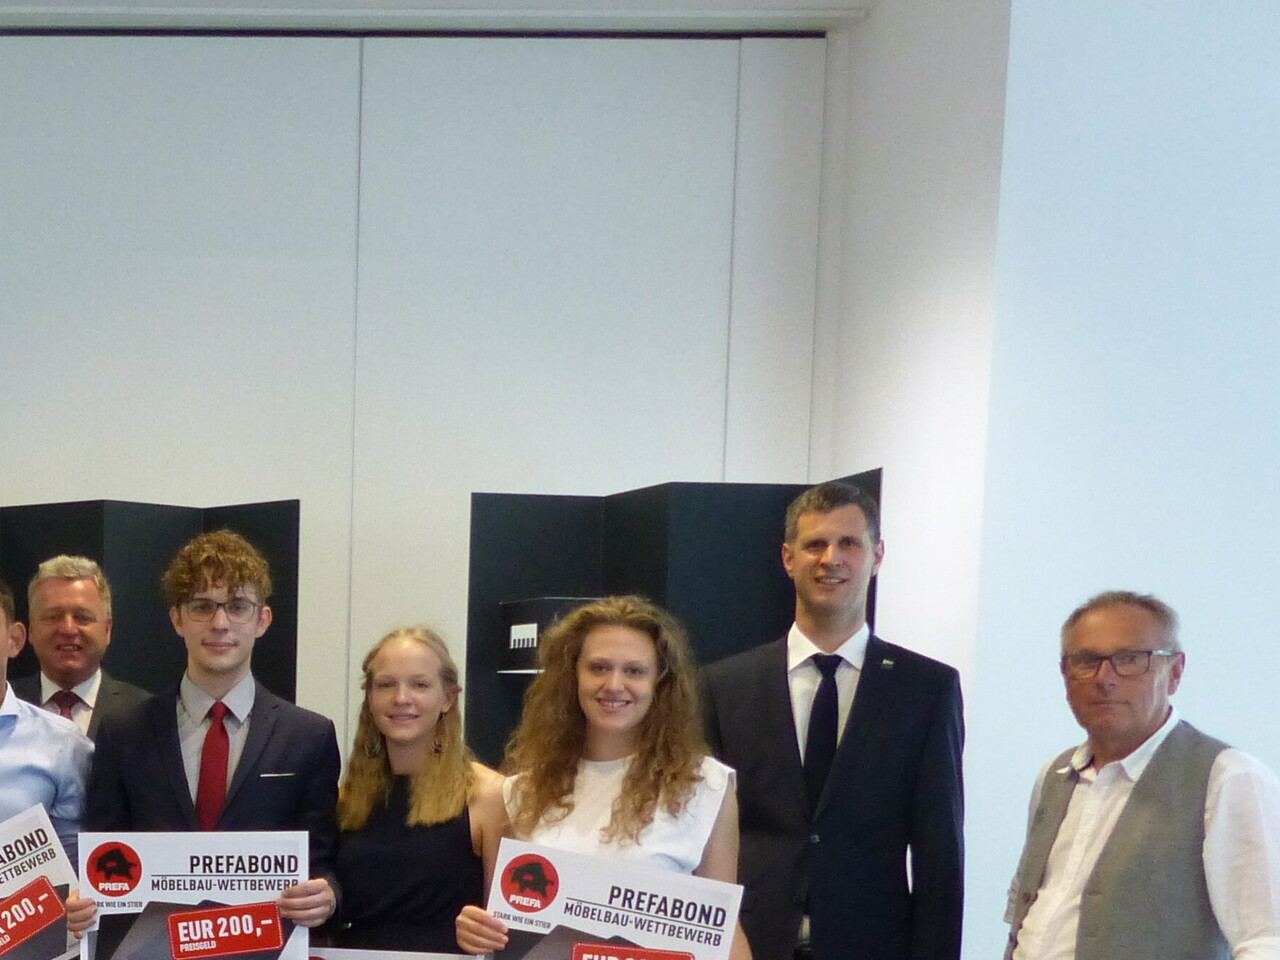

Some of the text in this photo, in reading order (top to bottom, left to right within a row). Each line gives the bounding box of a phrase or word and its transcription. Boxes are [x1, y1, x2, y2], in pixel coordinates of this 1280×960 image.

[189, 855, 298, 873] PREFABOND
[98, 882, 130, 891] PREFA
[509, 894, 541, 909] PREFA
[608, 885, 727, 928] PREFABOND
[493, 911, 511, 921] STARK
[177, 919, 215, 943] EUR
[563, 902, 722, 947] MÖBELBAU-WETTBEWERB
[179, 940, 217, 953] PREISGELD
